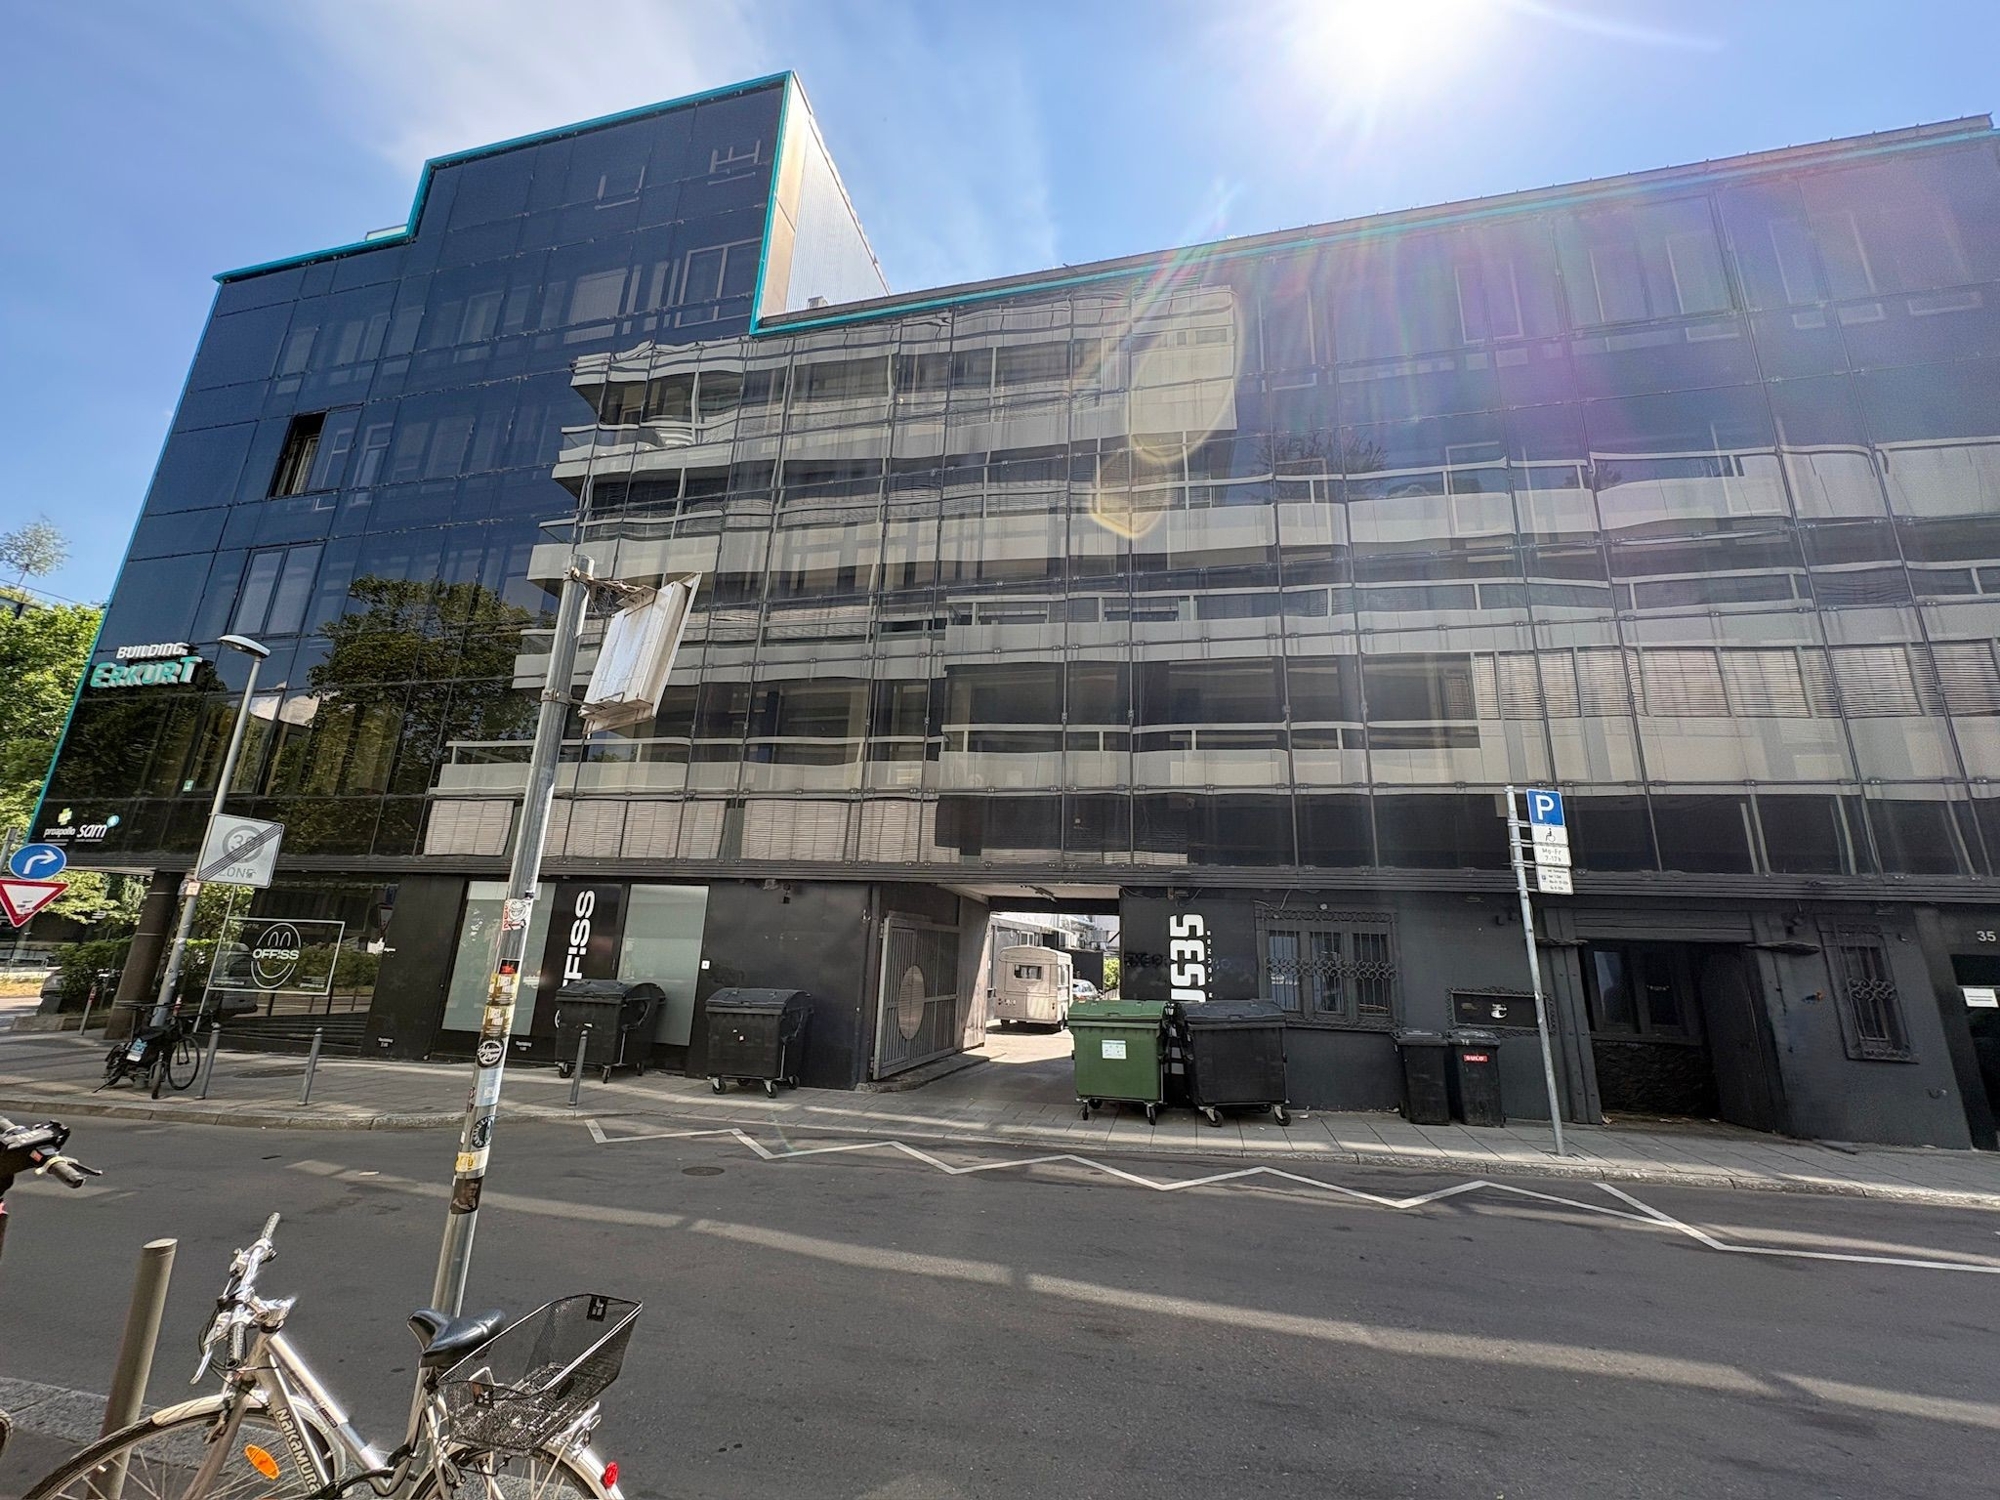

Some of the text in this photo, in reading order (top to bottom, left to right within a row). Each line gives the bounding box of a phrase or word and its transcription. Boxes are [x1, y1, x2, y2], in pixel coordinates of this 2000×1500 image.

[116, 642, 190, 659] BUILDING
[90, 656, 203, 688] ERKURT
[1535, 795, 1555, 820] P
[76, 824, 108, 838] sam
[1976, 930, 1997, 942] 35
